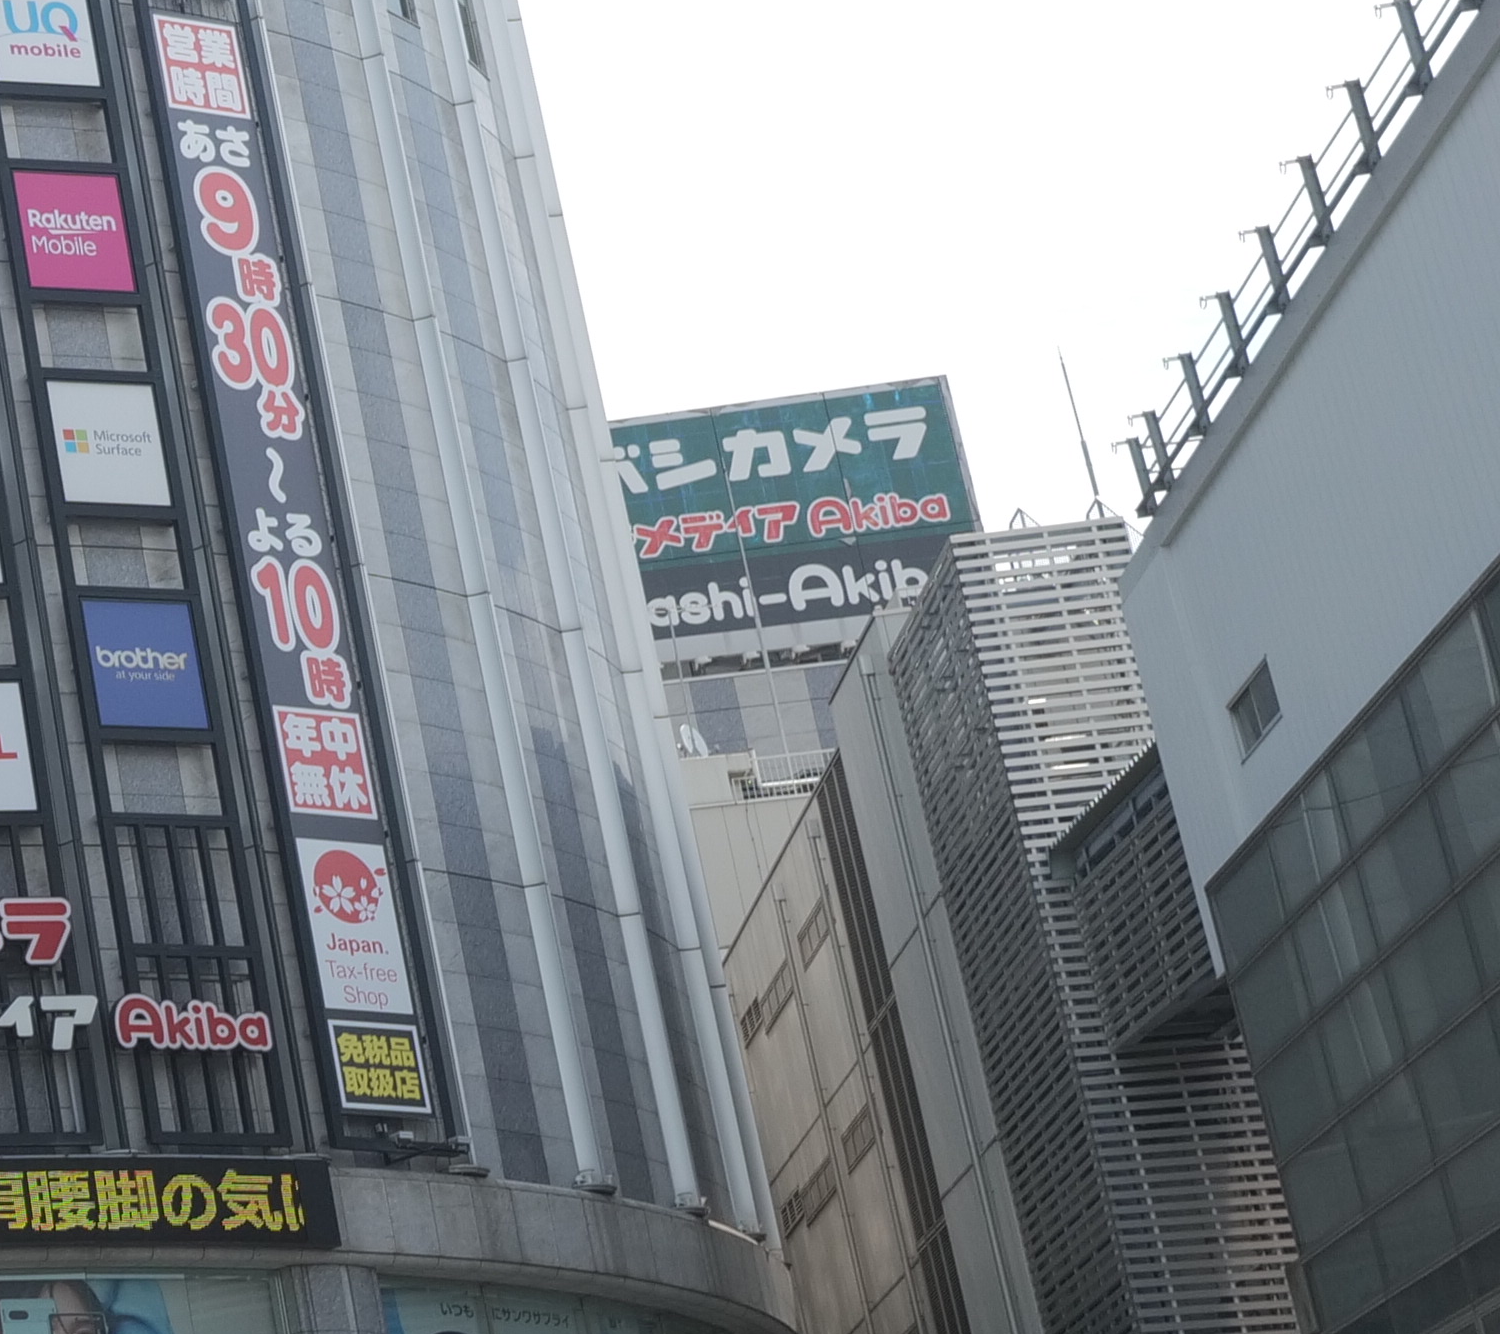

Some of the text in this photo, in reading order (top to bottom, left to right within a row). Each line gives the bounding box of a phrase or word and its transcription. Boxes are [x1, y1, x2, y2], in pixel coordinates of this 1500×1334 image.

[9, 41, 82, 61] mobile
[26, 207, 117, 233] Rakuten
[31, 234, 97, 258] Mobile
[93, 428, 152, 445] Microsoft
[94, 442, 143, 458] Surface
[807, 493, 951, 537] Akiba
[95, 645, 187, 670] brother
[326, 933, 389, 956] Japan.
[325, 959, 398, 985] Tax-free
[344, 985, 389, 1009] Shop
[114, 993, 274, 1054] Akiba
[335, 1032, 417, 1067] 免税品
[343, 1065, 422, 1103] 取扱店
